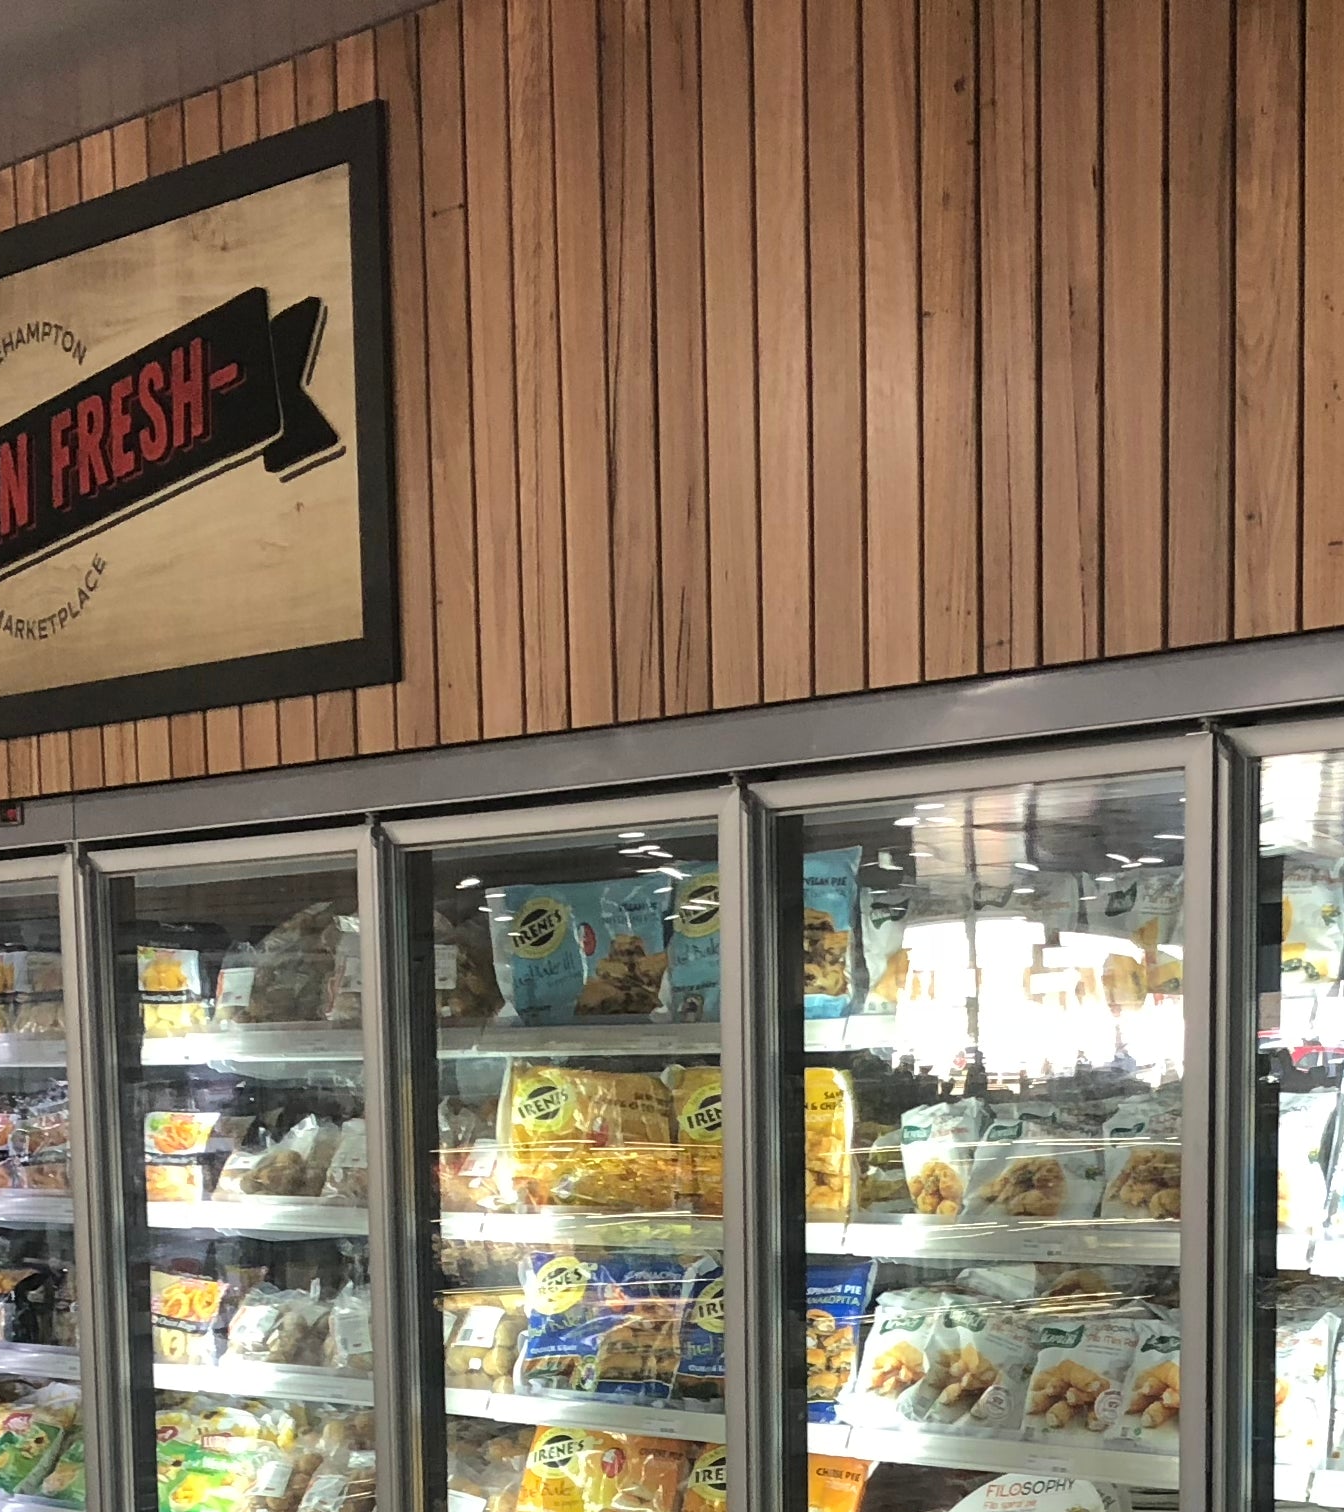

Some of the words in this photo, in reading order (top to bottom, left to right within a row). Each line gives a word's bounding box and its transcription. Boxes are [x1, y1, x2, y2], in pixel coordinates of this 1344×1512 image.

[50, 336, 212, 511] FRESH
[533, 1439, 585, 1463] IRENE'S
[986, 1477, 1076, 1498] FILOSOPHY
